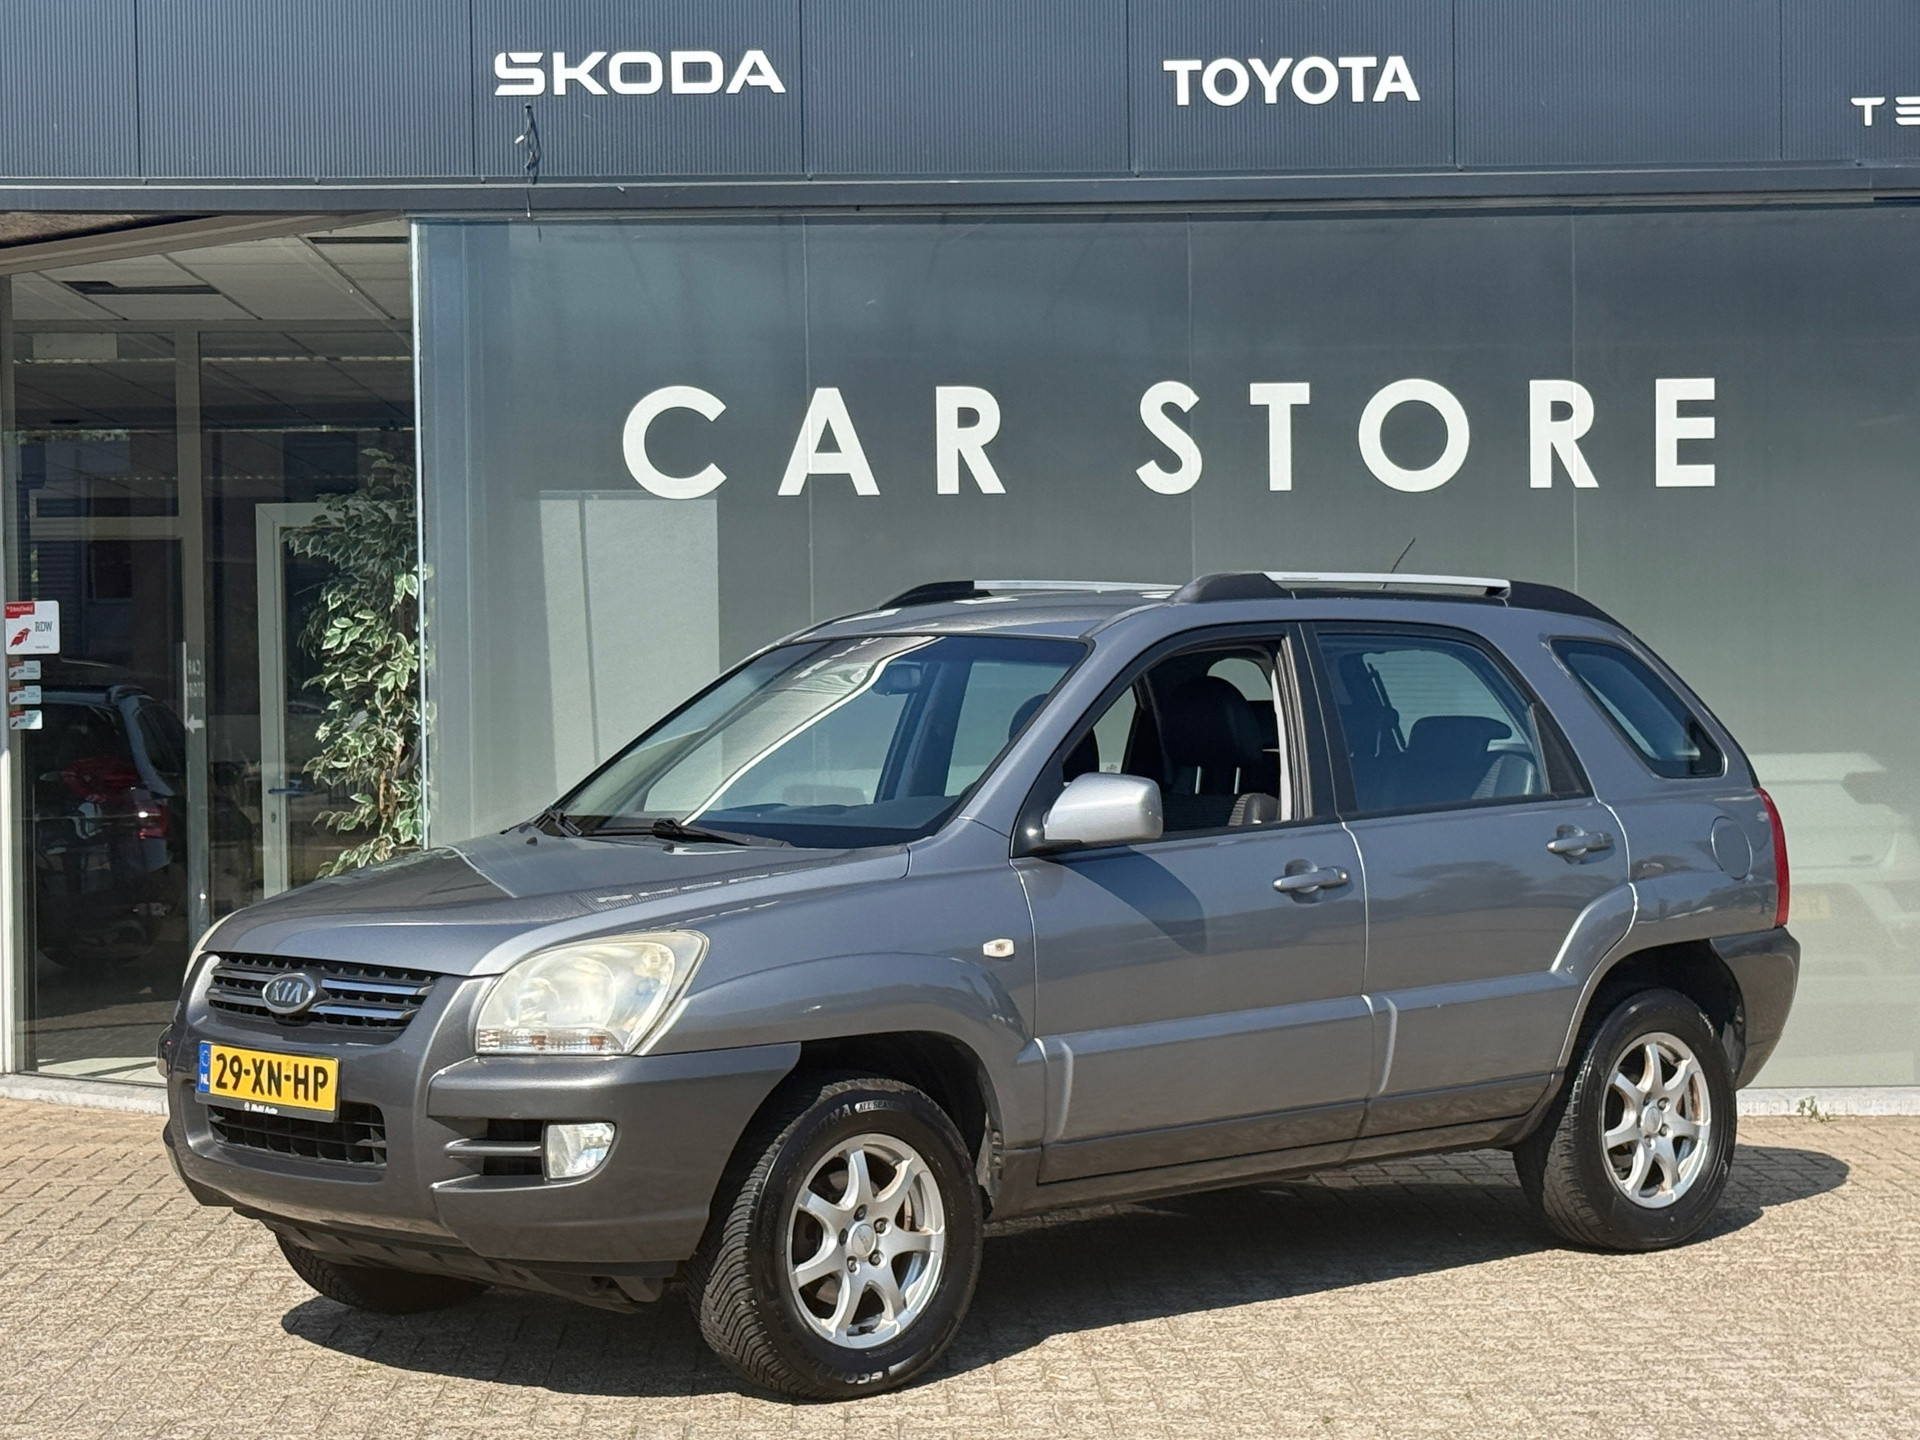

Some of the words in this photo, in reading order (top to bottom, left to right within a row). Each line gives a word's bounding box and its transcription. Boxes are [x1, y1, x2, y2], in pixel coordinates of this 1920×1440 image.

[495, 50, 786, 95] SKODA
[1163, 56, 1421, 106] TOYOTA
[622, 386, 1006, 499] CAR
[1136, 378, 1716, 494] STORE
[35, 621, 53, 632] RDW
[200, 1072, 209, 1085] NL
[215, 1053, 329, 1103] 29-XN-HP
